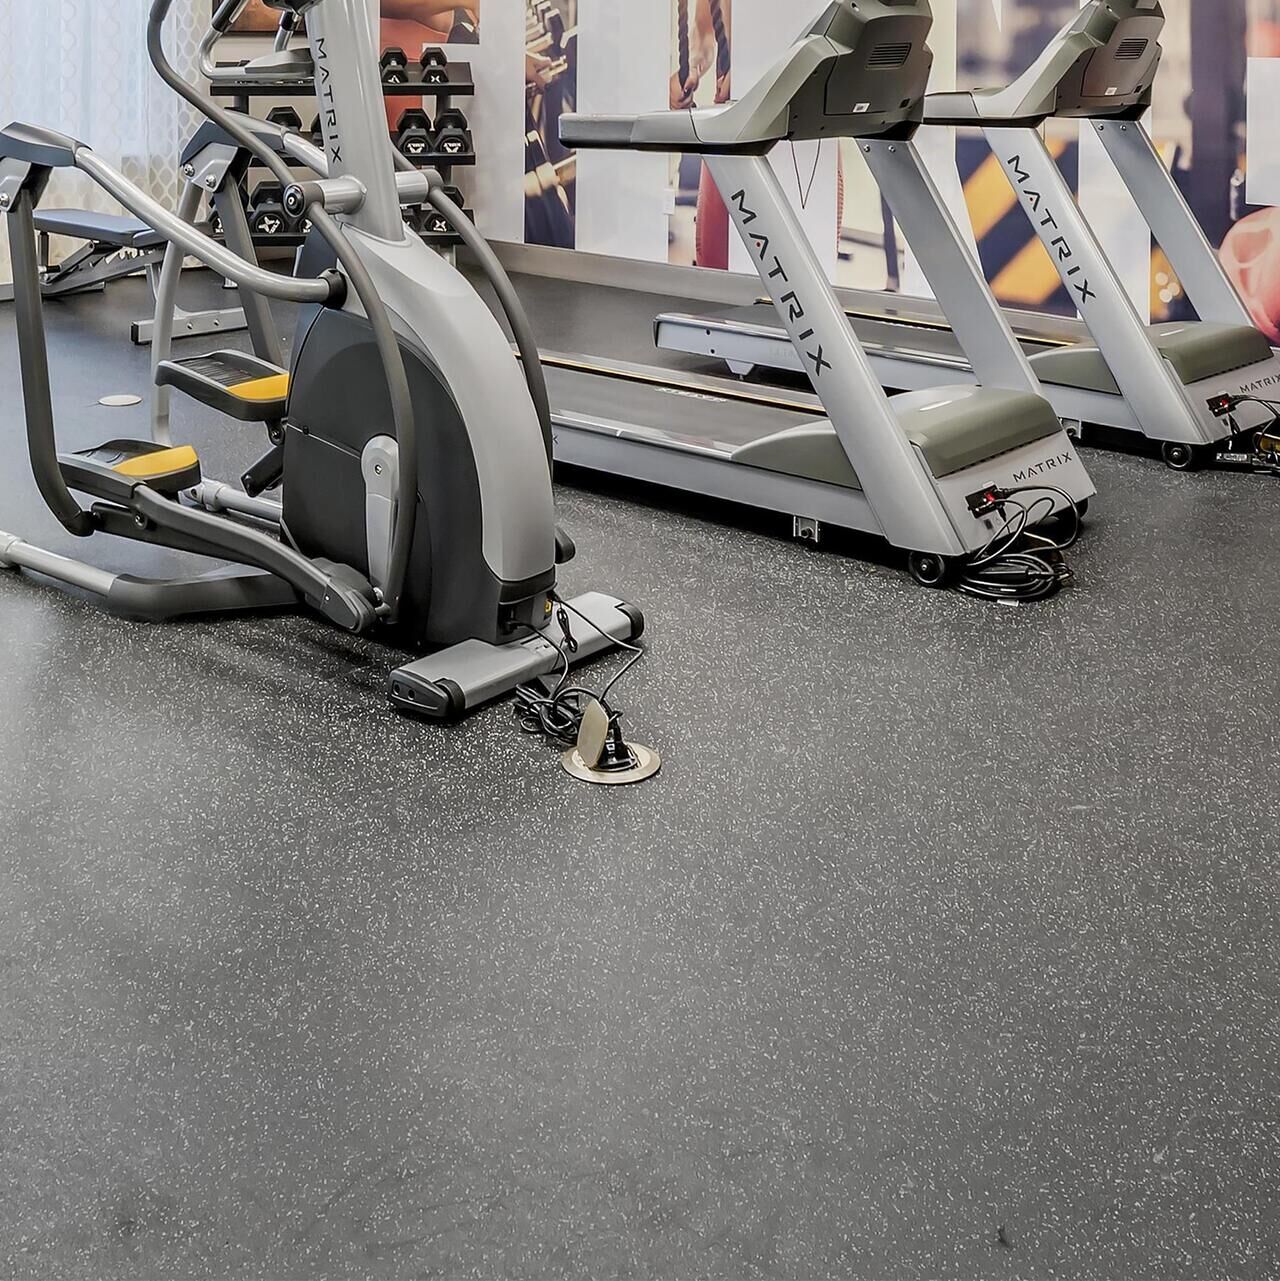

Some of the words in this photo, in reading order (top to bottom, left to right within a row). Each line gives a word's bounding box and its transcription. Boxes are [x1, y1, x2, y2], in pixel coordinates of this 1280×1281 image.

[315, 38, 342, 163] MATRIX
[731, 189, 831, 377] MATRIX
[1007, 154, 1096, 305] MATRIX
[1012, 452, 1073, 483] MATRIX
